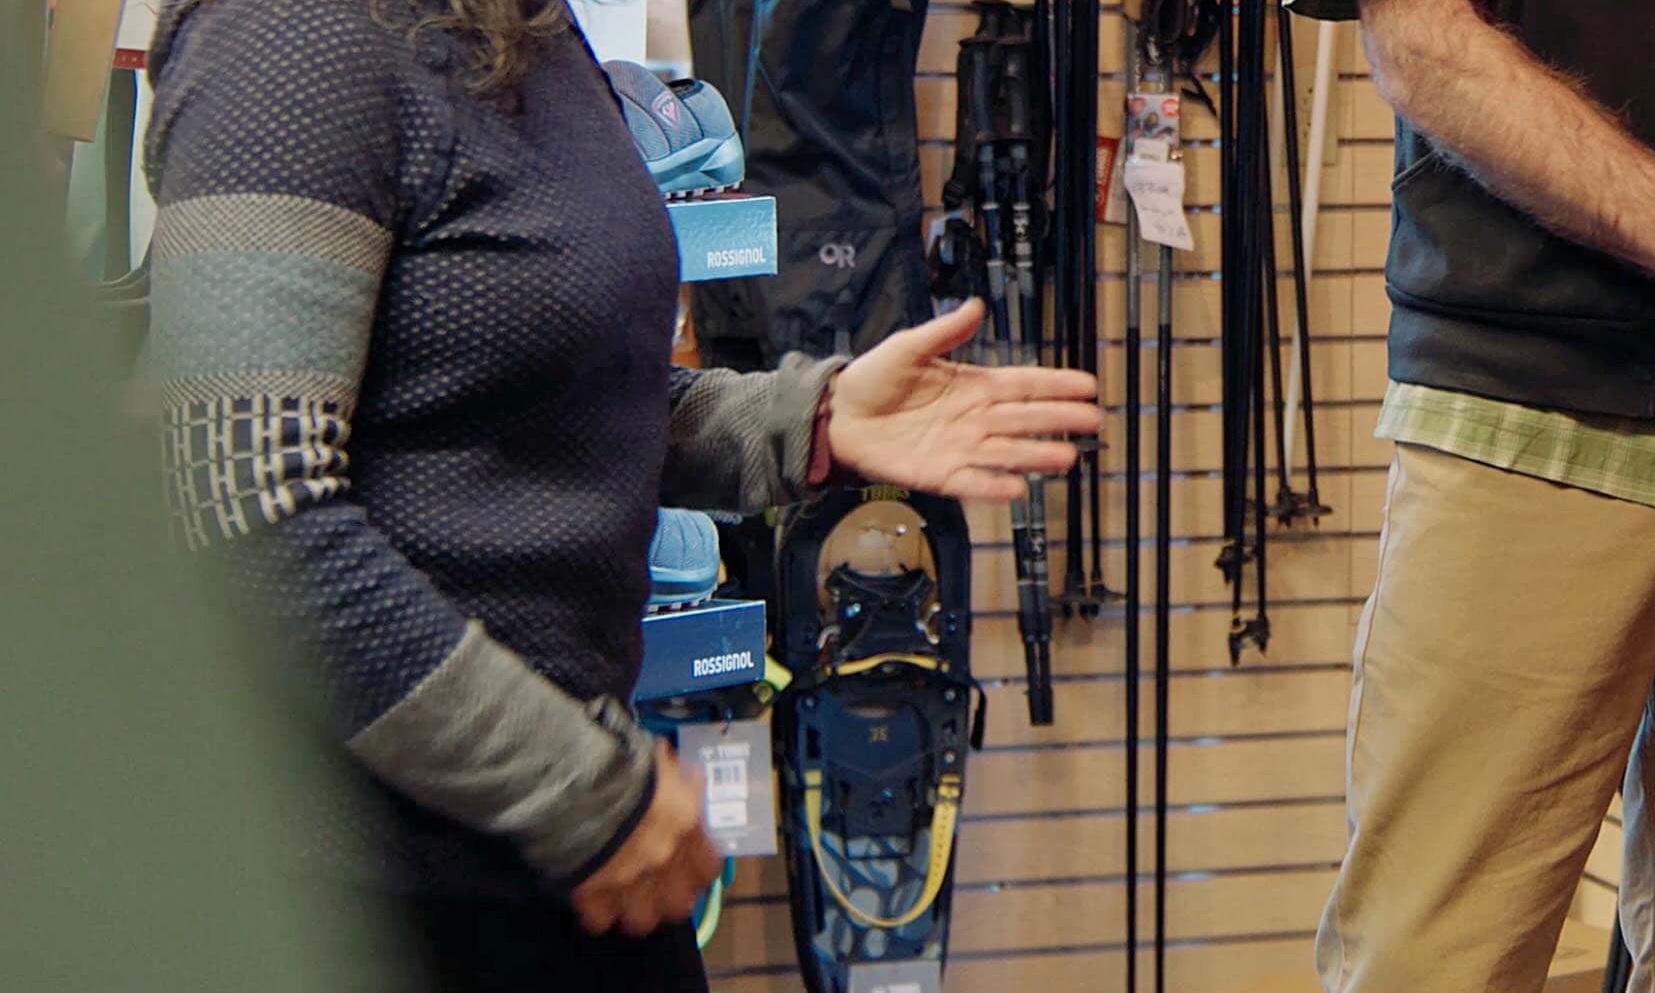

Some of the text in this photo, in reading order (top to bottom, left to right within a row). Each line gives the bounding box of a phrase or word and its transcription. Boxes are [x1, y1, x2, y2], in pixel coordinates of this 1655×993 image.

[707, 247, 766, 269] ROSSIGNOL
[819, 241, 856, 269] OR
[693, 651, 755, 677] ROSSIGNOL
